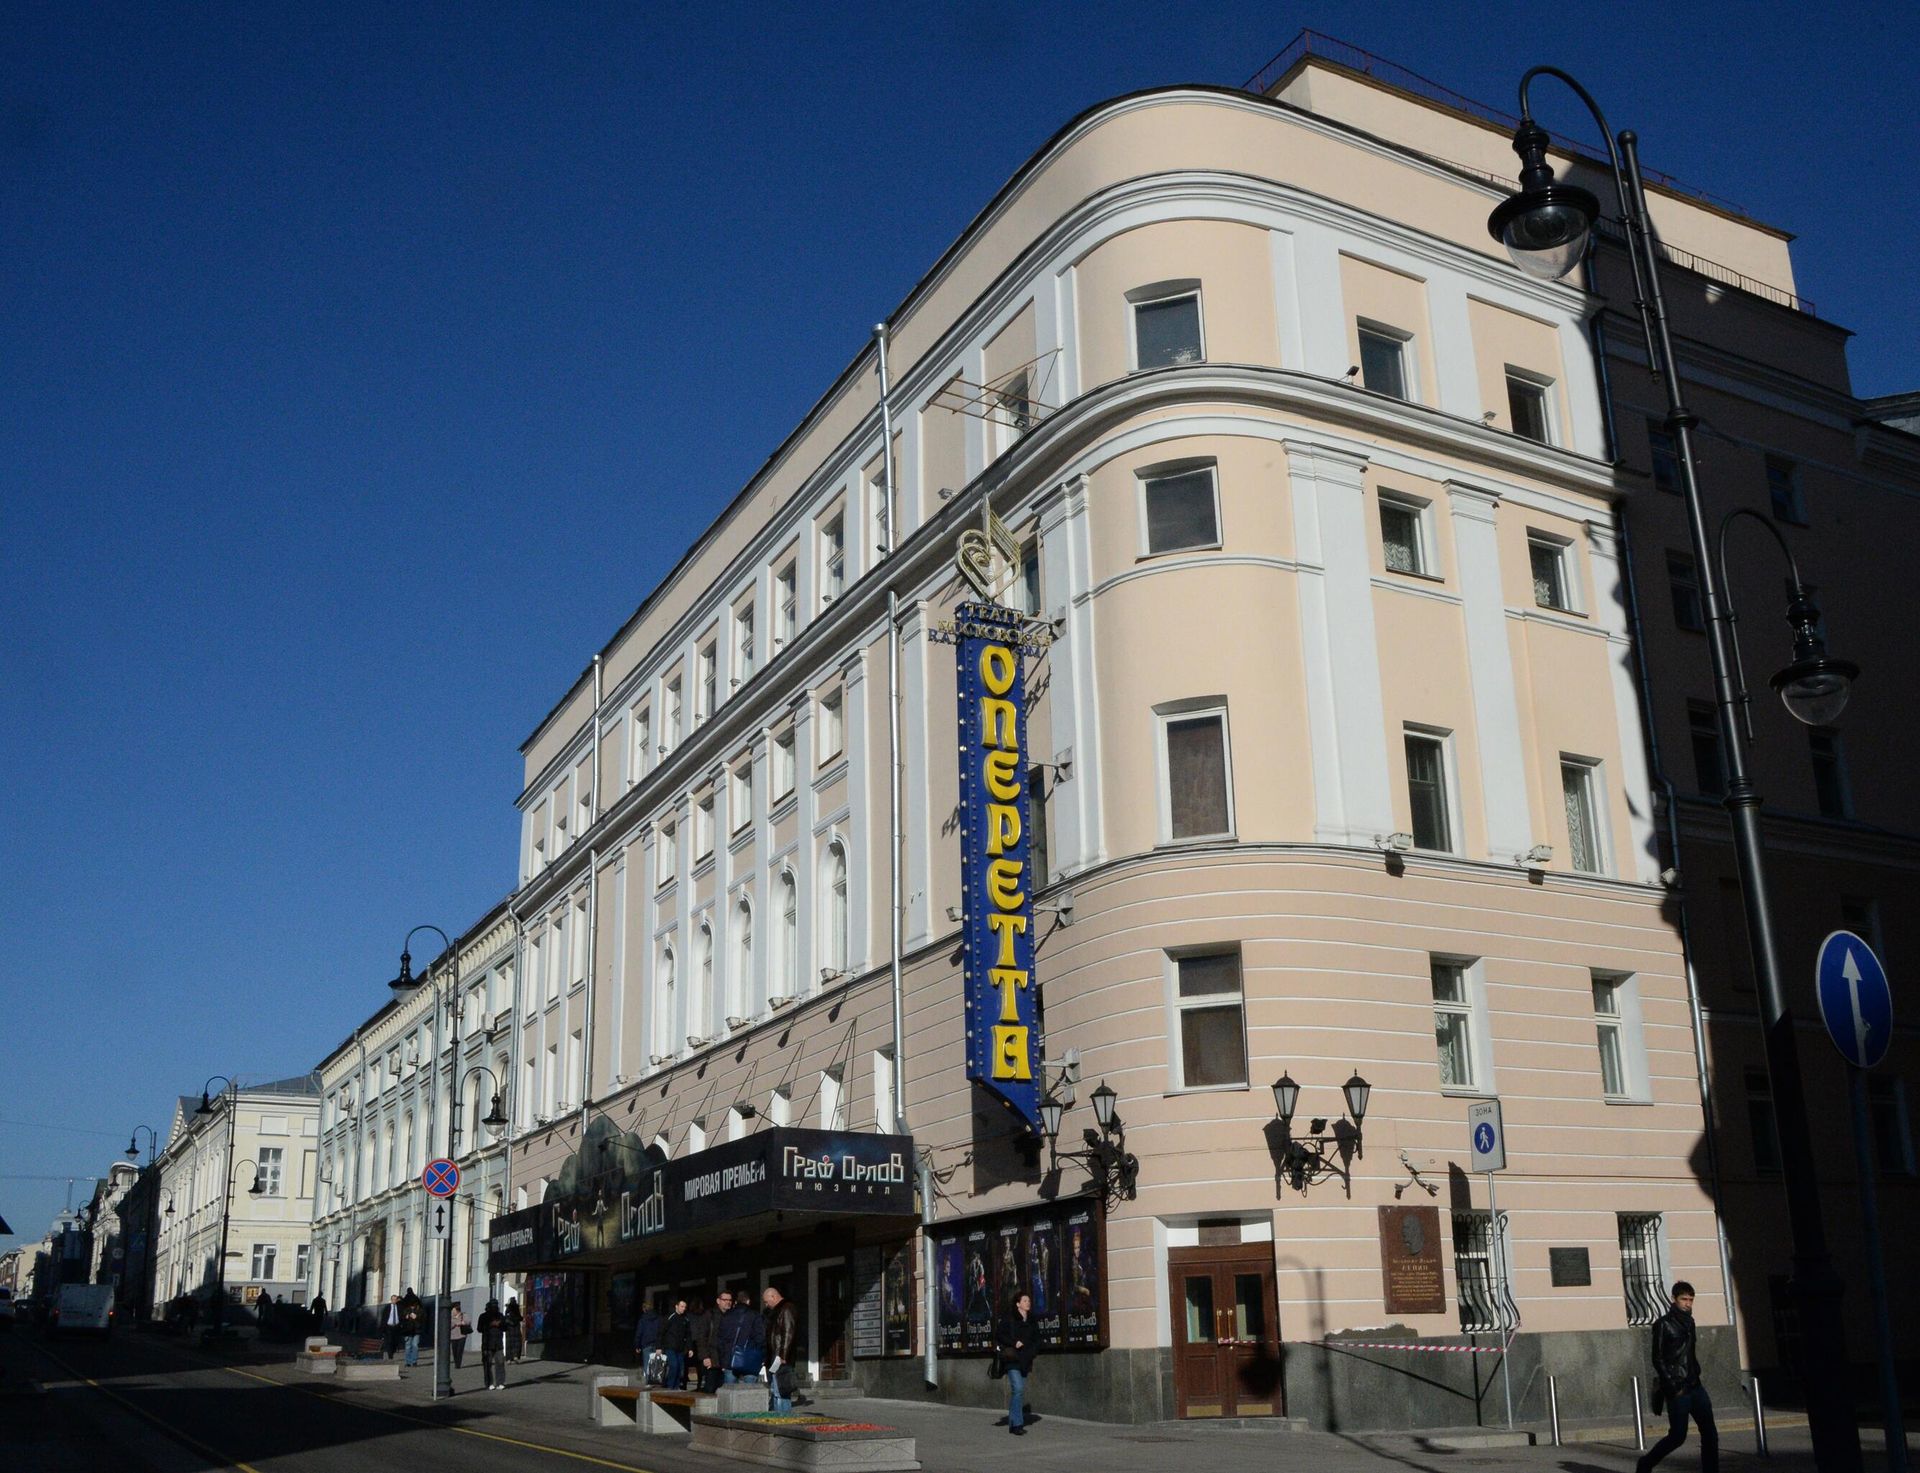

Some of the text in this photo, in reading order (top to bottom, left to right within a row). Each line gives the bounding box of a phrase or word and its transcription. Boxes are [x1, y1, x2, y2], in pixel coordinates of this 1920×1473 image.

[965, 603, 1024, 624] ТЕАТР
[938, 620, 1052, 648] МОСКОВСКАЯ
[980, 645, 1032, 1081] ОПЕРЕТТА
[1475, 1106, 1493, 1117] ЗОНА
[684, 1161, 766, 1201] МИРОВАЯ ПРЕМЬЕРА
[795, 1181, 890, 1195] МЮЗИКЛ
[511, 1227, 534, 1247] ПРЕМЬЕРА
